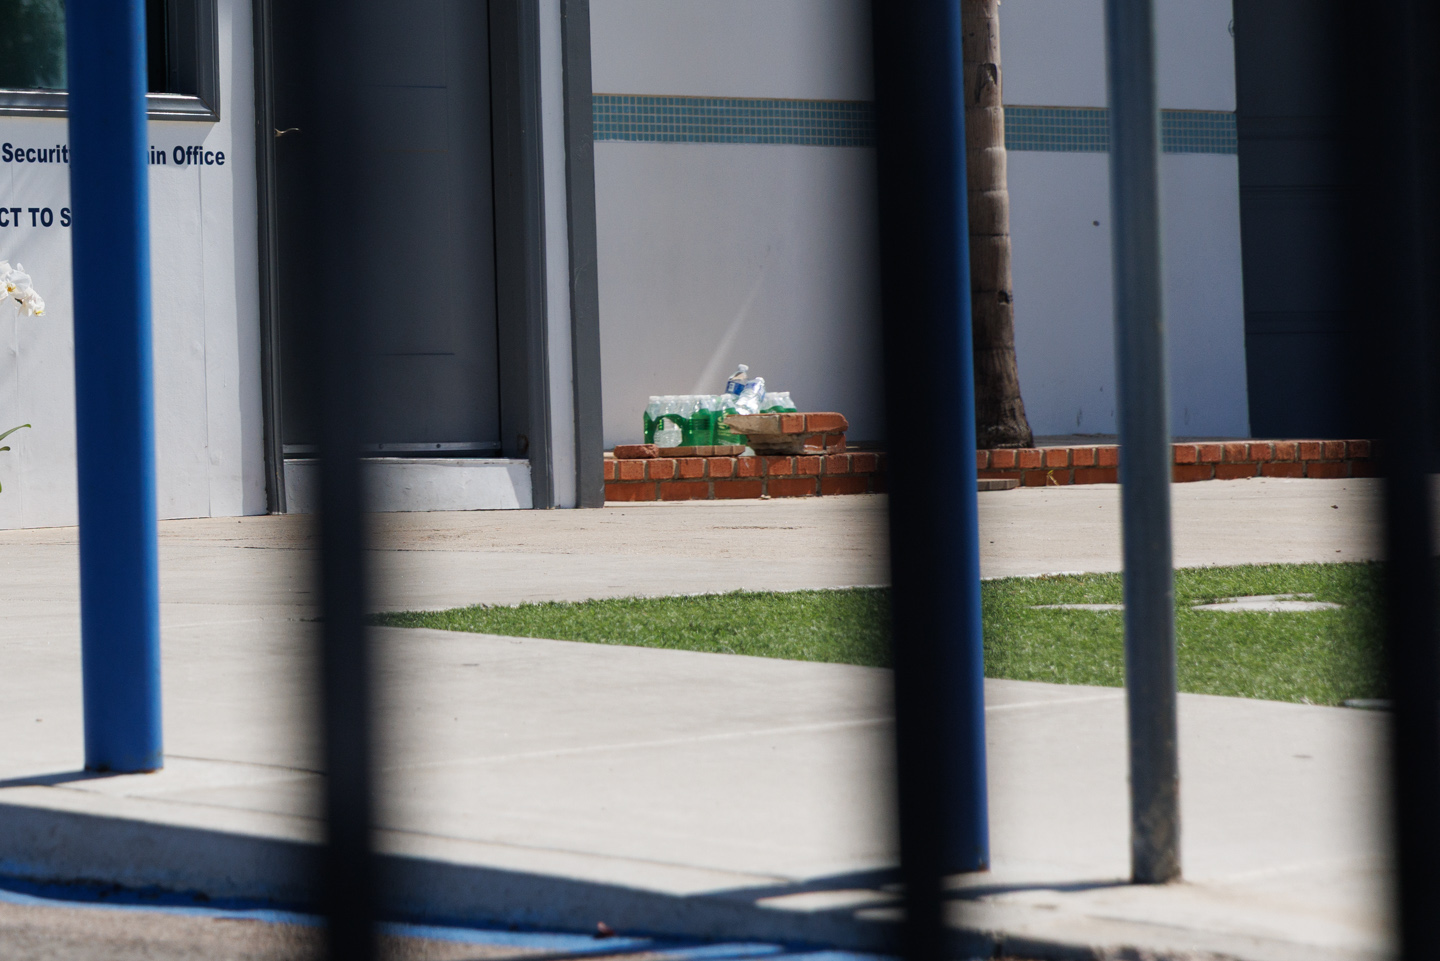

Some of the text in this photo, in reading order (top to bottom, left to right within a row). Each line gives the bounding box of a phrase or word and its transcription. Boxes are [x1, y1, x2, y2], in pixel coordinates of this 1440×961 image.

[1, 142, 71, 166] Securit
[172, 145, 226, 166] Office
[28, 207, 54, 228] TO
